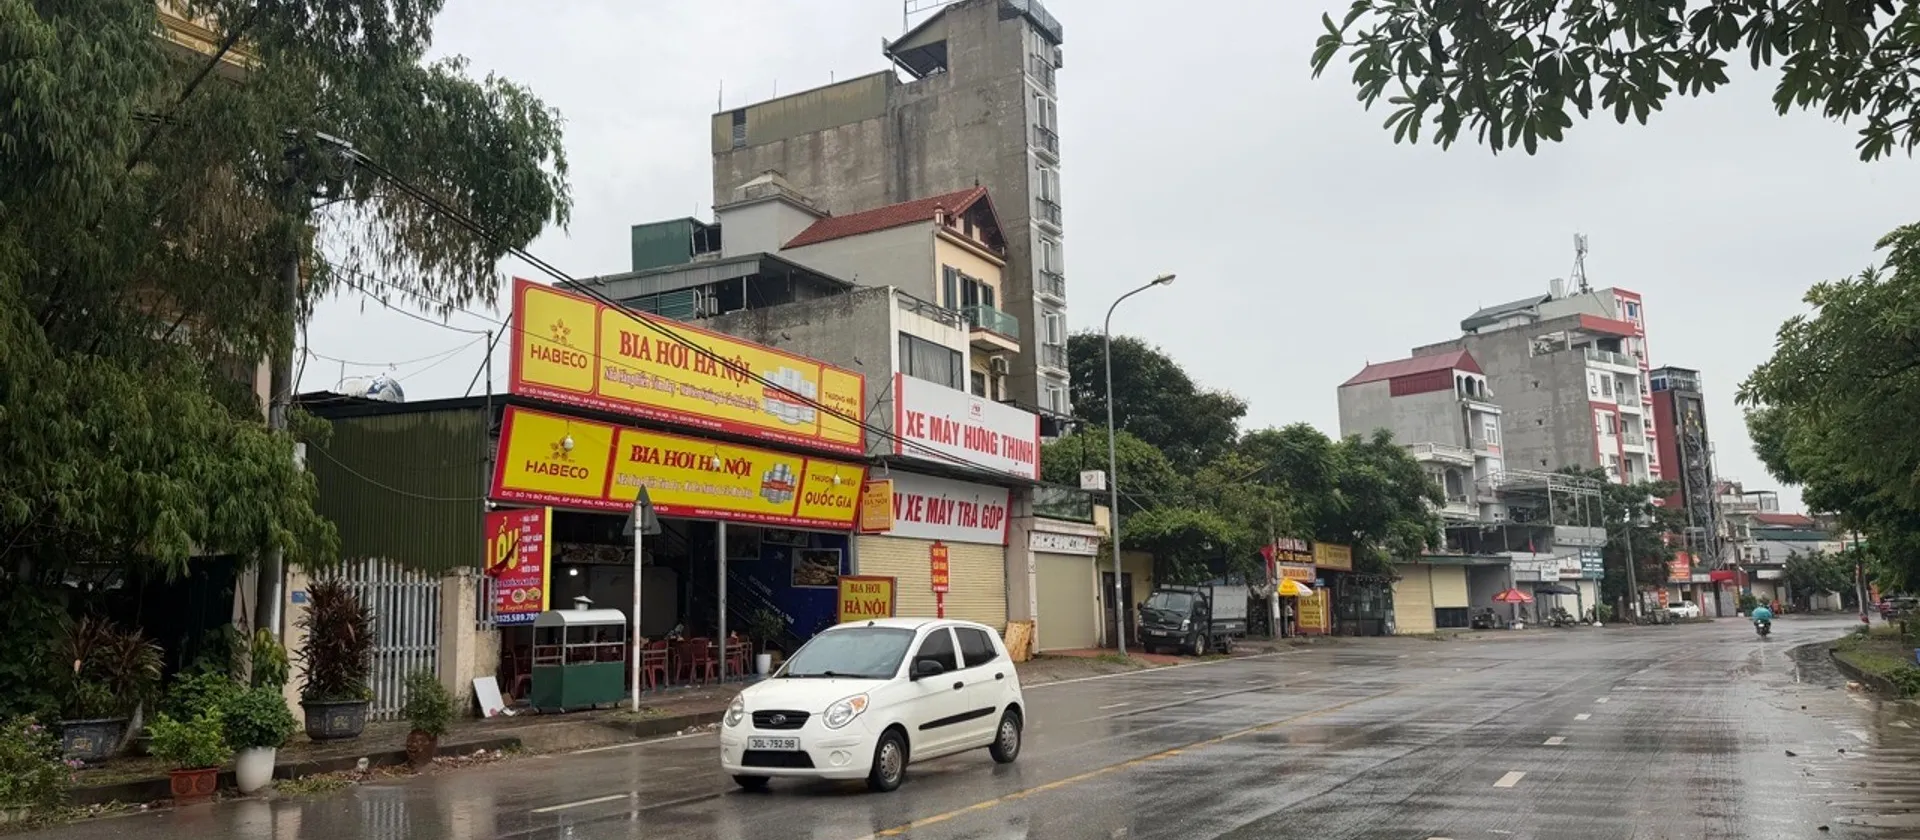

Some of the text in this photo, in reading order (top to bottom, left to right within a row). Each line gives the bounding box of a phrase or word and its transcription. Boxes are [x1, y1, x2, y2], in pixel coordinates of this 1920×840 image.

[530, 343, 588, 370] HABECO
[619, 330, 752, 388] BIA HƠI HÀ NỘI
[906, 410, 925, 439] XE
[930, 414, 960, 446] MÁY
[964, 425, 998, 455] HƯNG
[1002, 434, 1034, 466] THỊNH
[525, 459, 589, 481] HABECO
[629, 444, 661, 467] BIA
[665, 448, 697, 470] HƠI
[724, 454, 752, 479] NỘI
[811, 473, 839, 482] THƯƠN
[805, 488, 852, 508] QUỐC GIA
[905, 494, 923, 522] XE
[926, 493, 955, 525] MÁY
[957, 494, 978, 527] TRẢ
[981, 500, 1004, 530] GÓP
[850, 583, 880, 594] BIA HƠI
[844, 596, 886, 618] HÀ NỘI
